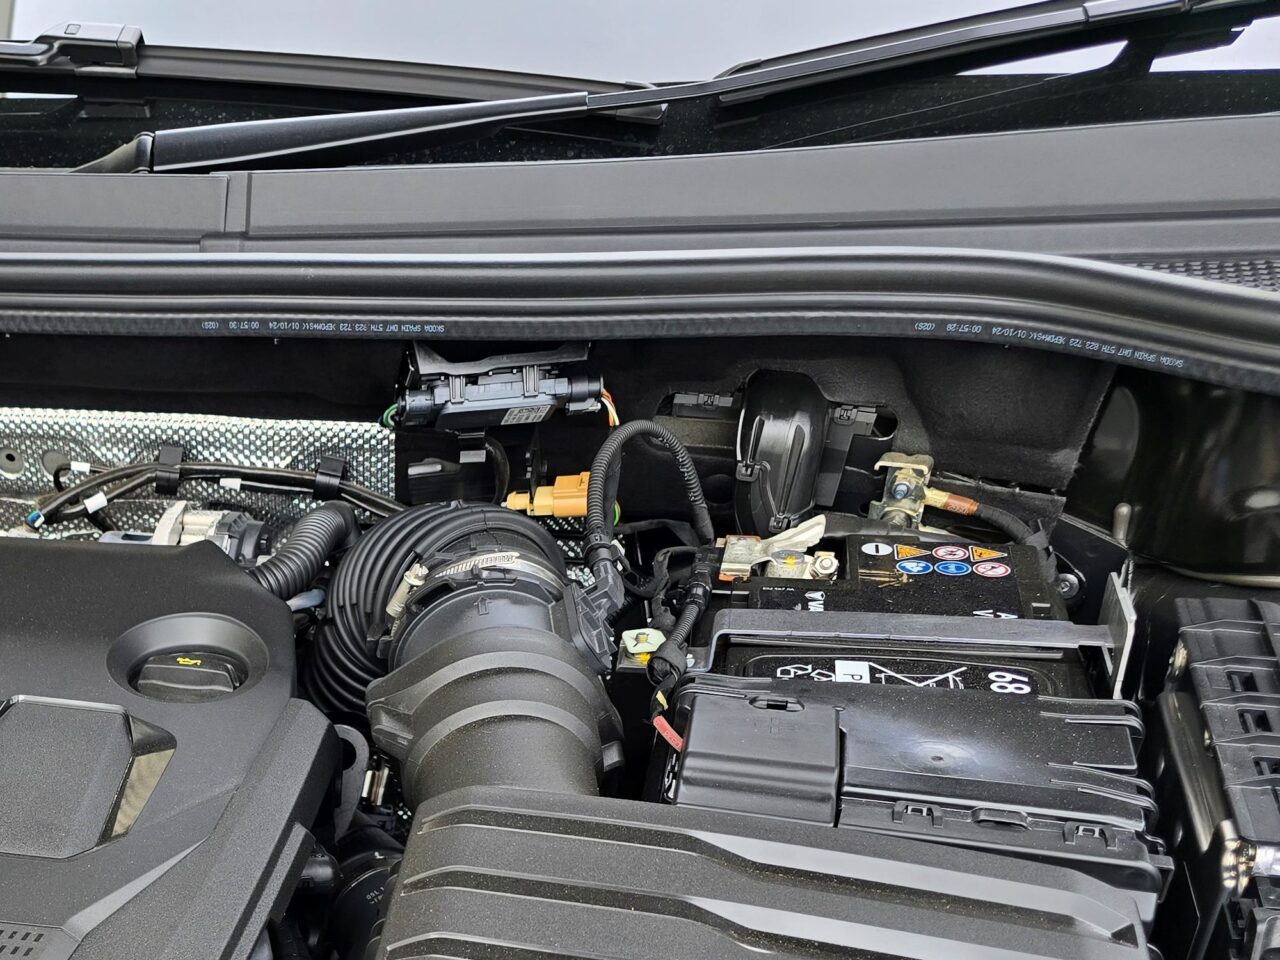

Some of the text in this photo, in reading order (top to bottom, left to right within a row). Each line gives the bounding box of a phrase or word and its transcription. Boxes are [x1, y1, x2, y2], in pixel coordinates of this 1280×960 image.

[268, 321, 300, 330] 01/10/24
[401, 323, 422, 333] SPAIN
[424, 324, 445, 333] SKODA
[991, 326, 1027, 339] 01/10/24
[1134, 350, 1157, 363] SPAIN
[1159, 354, 1184, 368] SKODA
